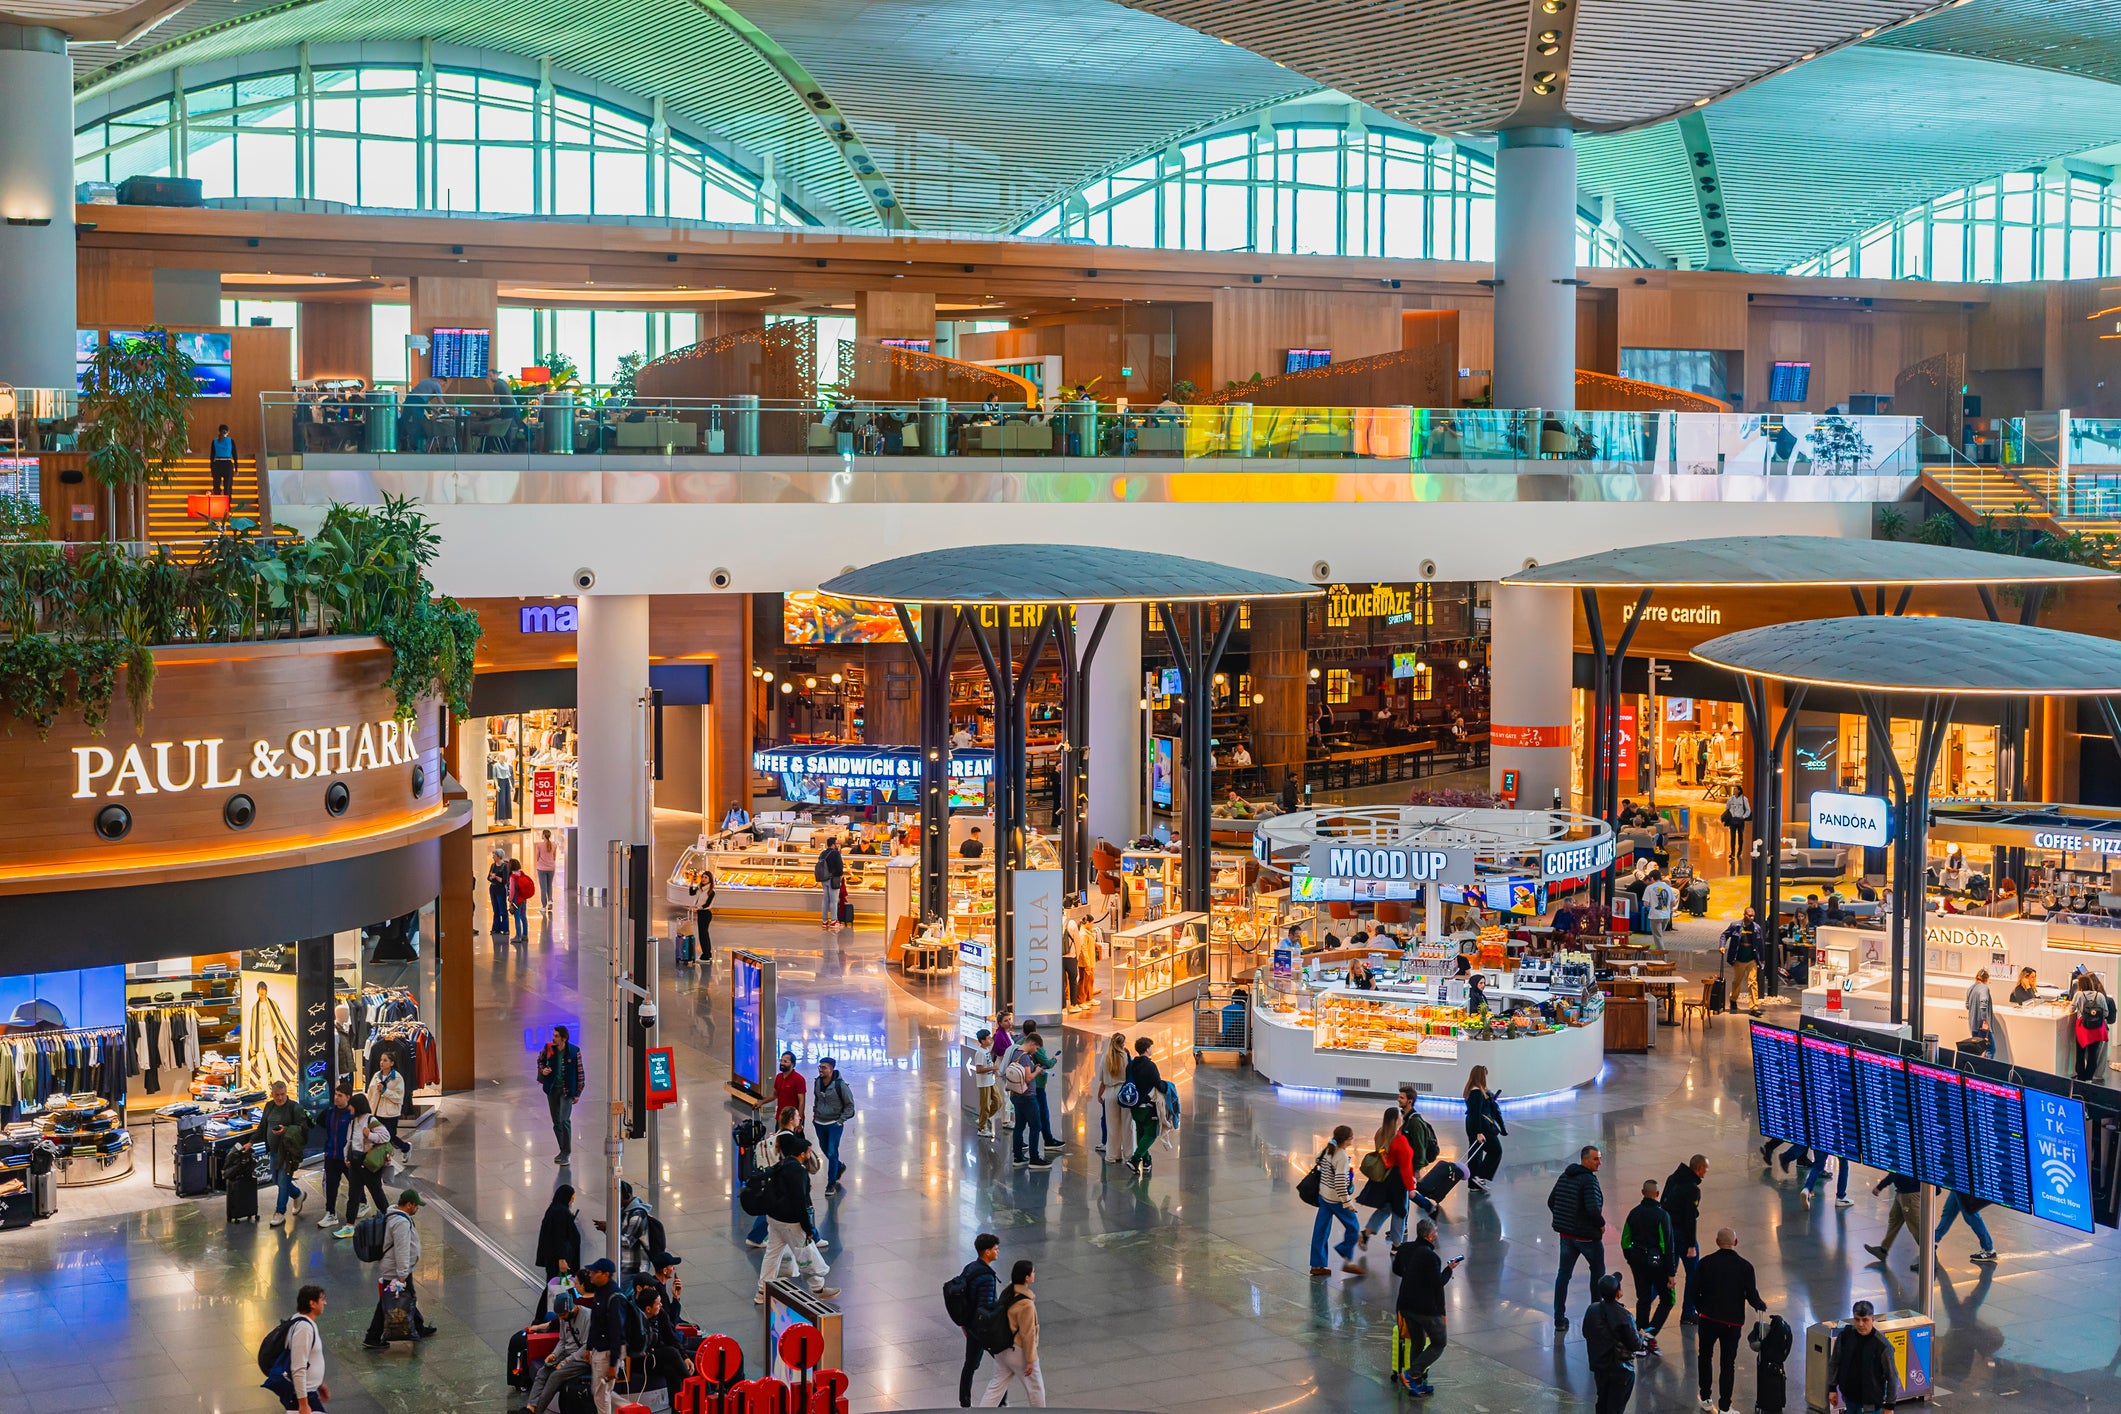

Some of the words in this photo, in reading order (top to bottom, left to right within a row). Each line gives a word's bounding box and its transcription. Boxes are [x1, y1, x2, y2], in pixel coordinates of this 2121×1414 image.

[1331, 592, 1411, 617] TICKERDAZE
[1671, 605, 1721, 625] cardin
[71, 737, 242, 799] PAUL
[250, 739, 285, 779] &
[290, 717, 420, 780] SHARK
[790, 758, 804, 773] &
[807, 758, 894, 776] SANDWICH
[897, 760, 911, 777] &
[833, 777, 847, 787] SIP
[855, 778, 870, 787] EAT
[535, 790, 554, 798] SALE
[1819, 812, 1877, 830] PANDORA
[2034, 832, 2082, 850] COFFEE
[1330, 848, 1407, 879] MOOD
[1411, 851, 1447, 880] UP
[1545, 847, 1591, 875] COFFEE
[1028, 891, 1049, 994] FURLA
[2045, 1117, 2065, 1135] TK
[2038, 1139, 2076, 1164] Wi-Fi
[2041, 1191, 2067, 1205] Connect
[2067, 1199, 2081, 1209] Now
